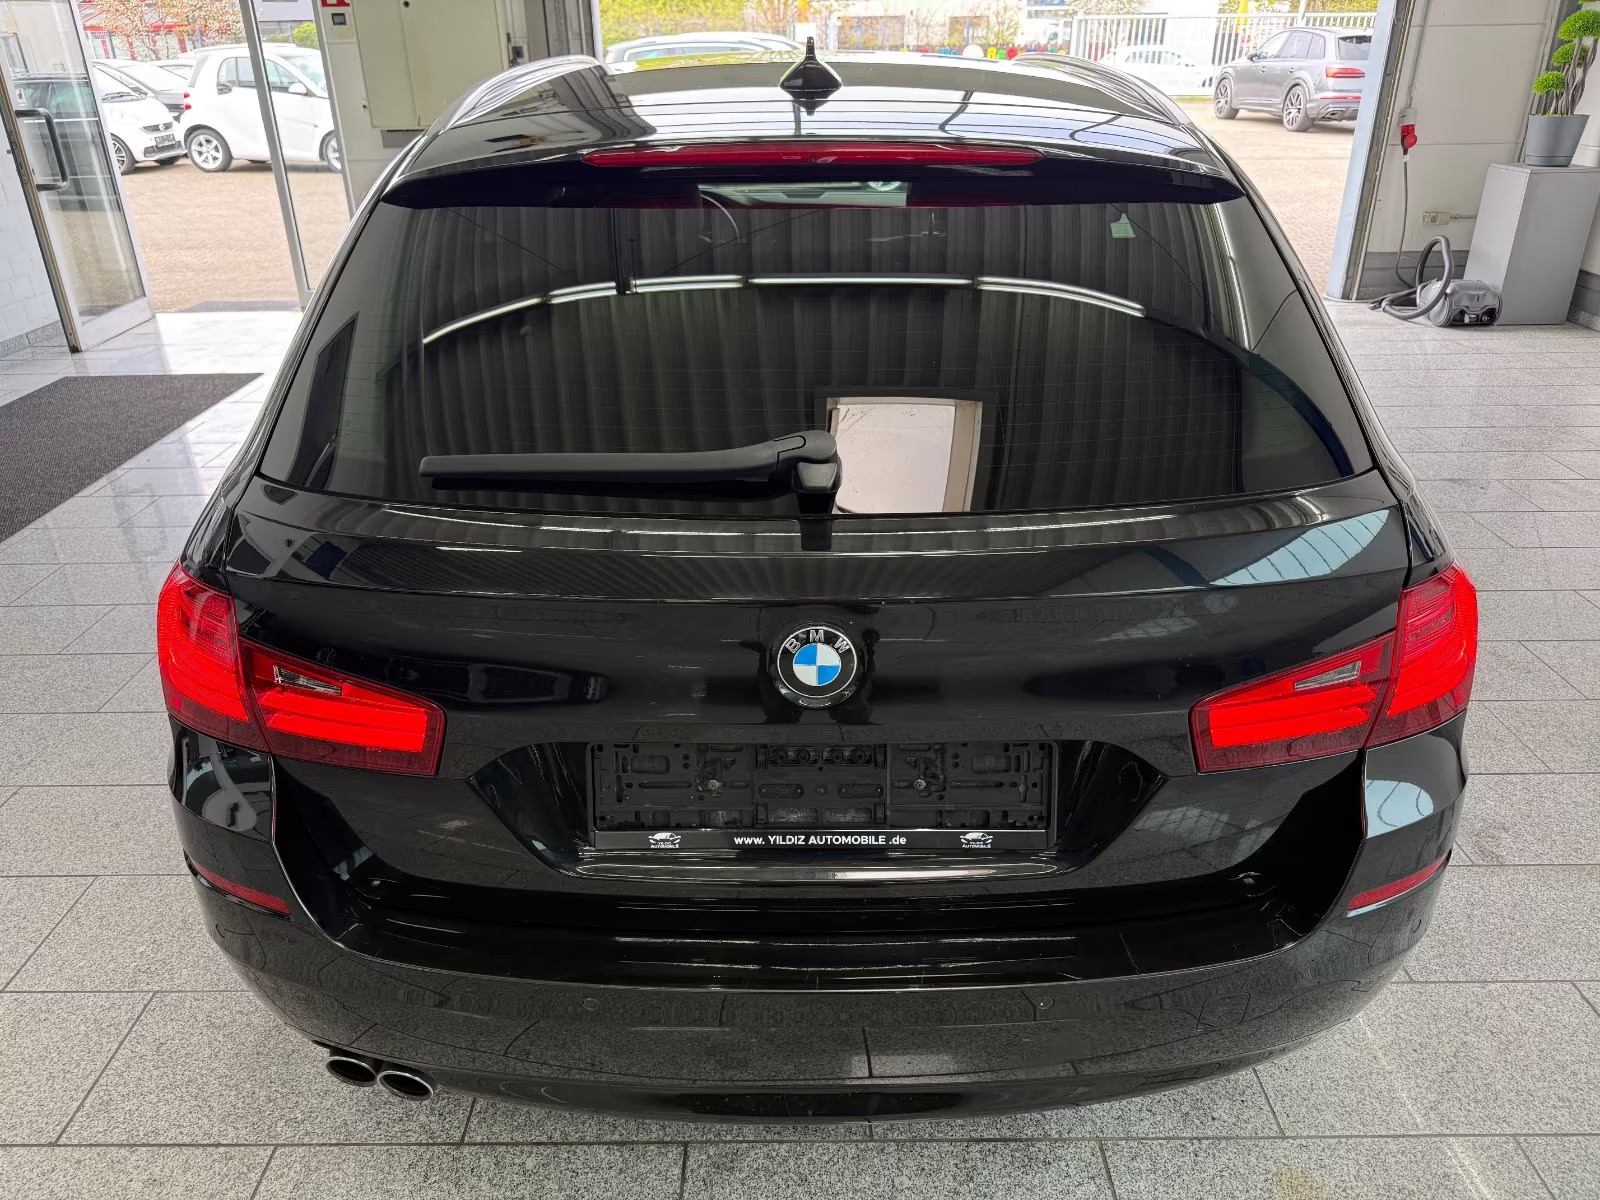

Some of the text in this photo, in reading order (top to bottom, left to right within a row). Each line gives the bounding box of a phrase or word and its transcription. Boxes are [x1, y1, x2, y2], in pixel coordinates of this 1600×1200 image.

[785, 629, 851, 653] BMW
[733, 834, 907, 845] www. YILDIZ AUTOMOBILE .de
